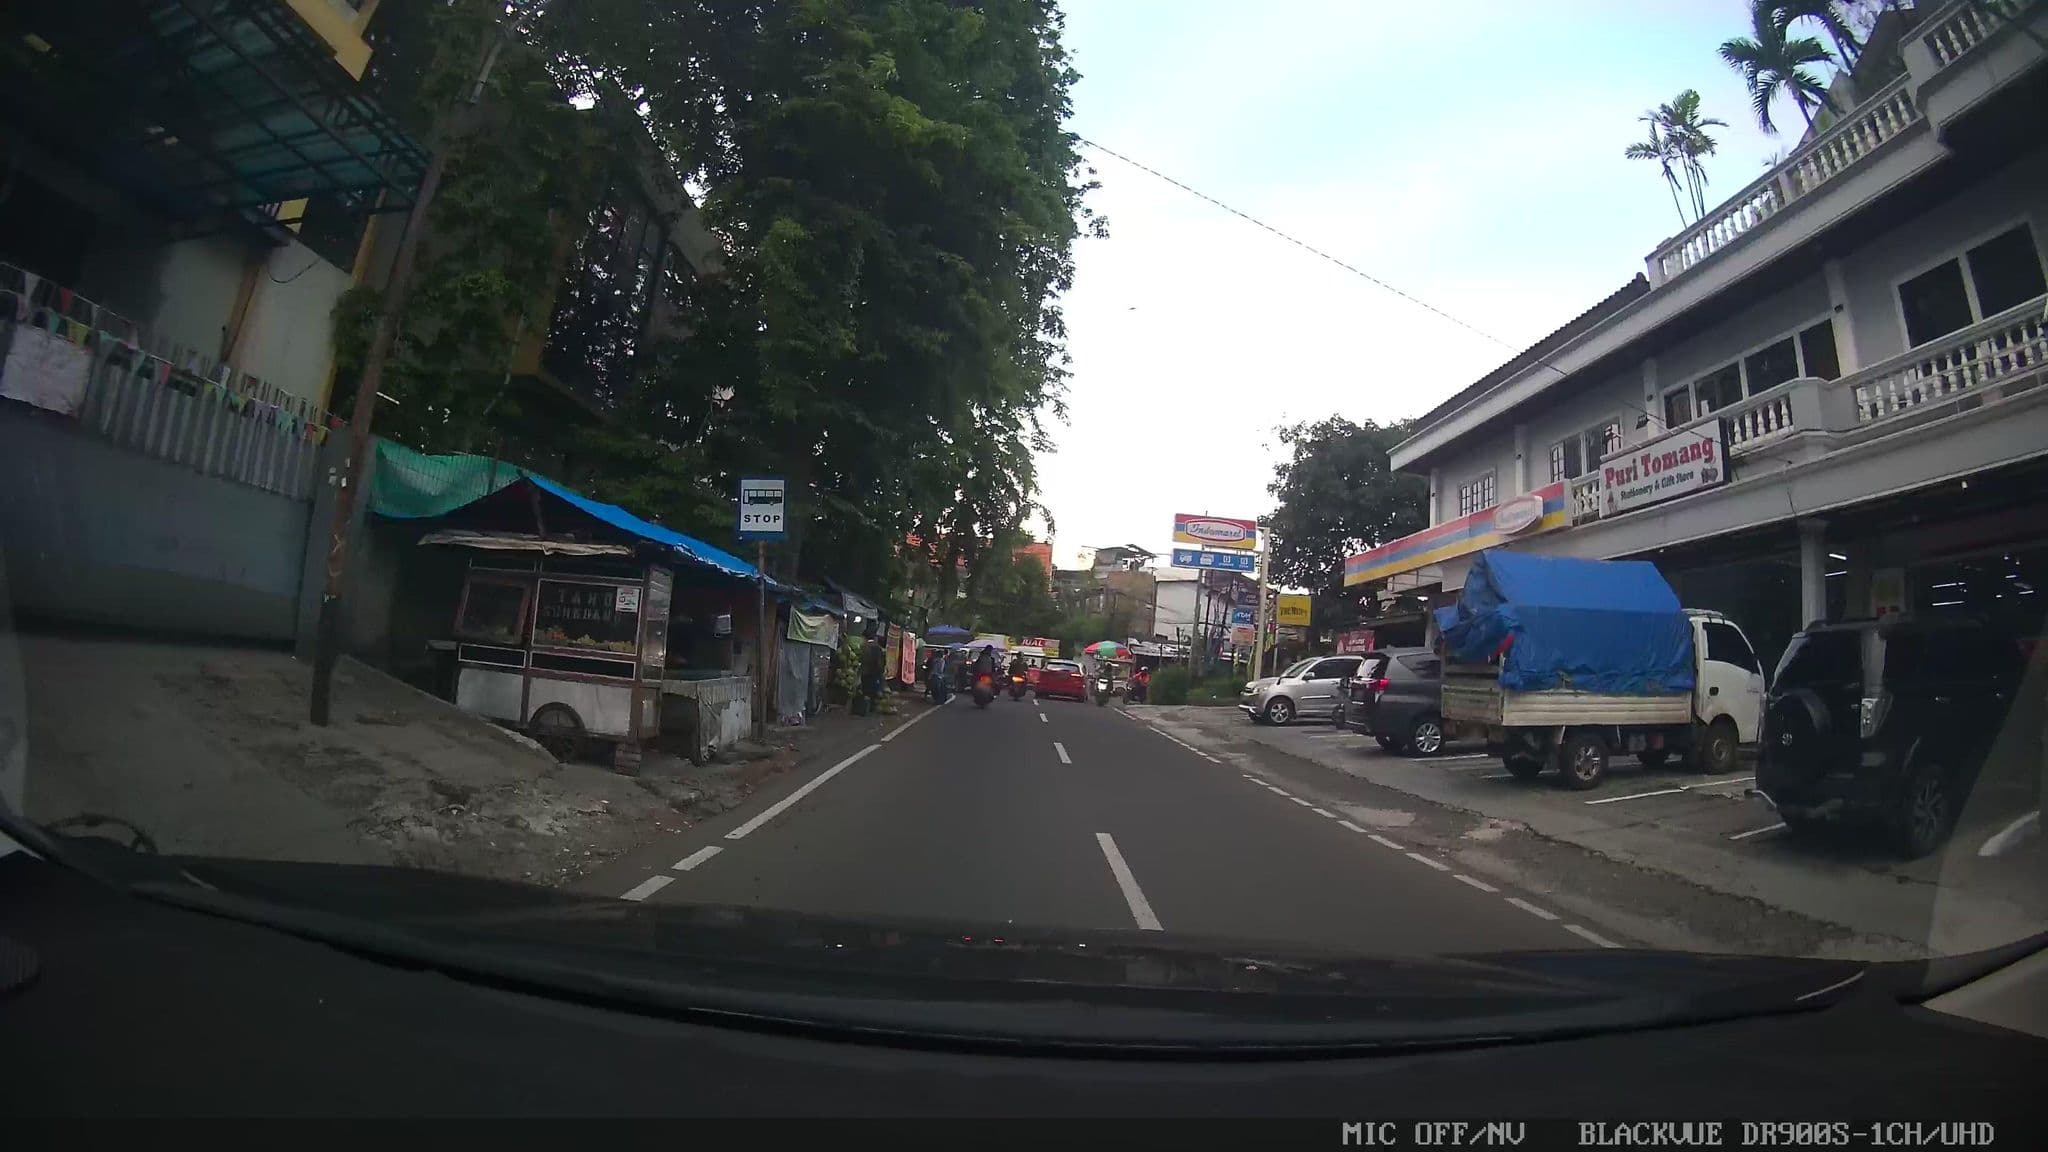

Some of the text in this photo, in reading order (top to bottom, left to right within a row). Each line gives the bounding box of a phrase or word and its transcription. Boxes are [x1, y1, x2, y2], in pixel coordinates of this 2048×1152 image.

[1604, 437, 1714, 490] Puri Tomang
[1620, 470, 1694, 501] Stationery & Gift Store
[743, 514, 782, 524] STOP
[1188, 523, 1242, 537] Indomaret
